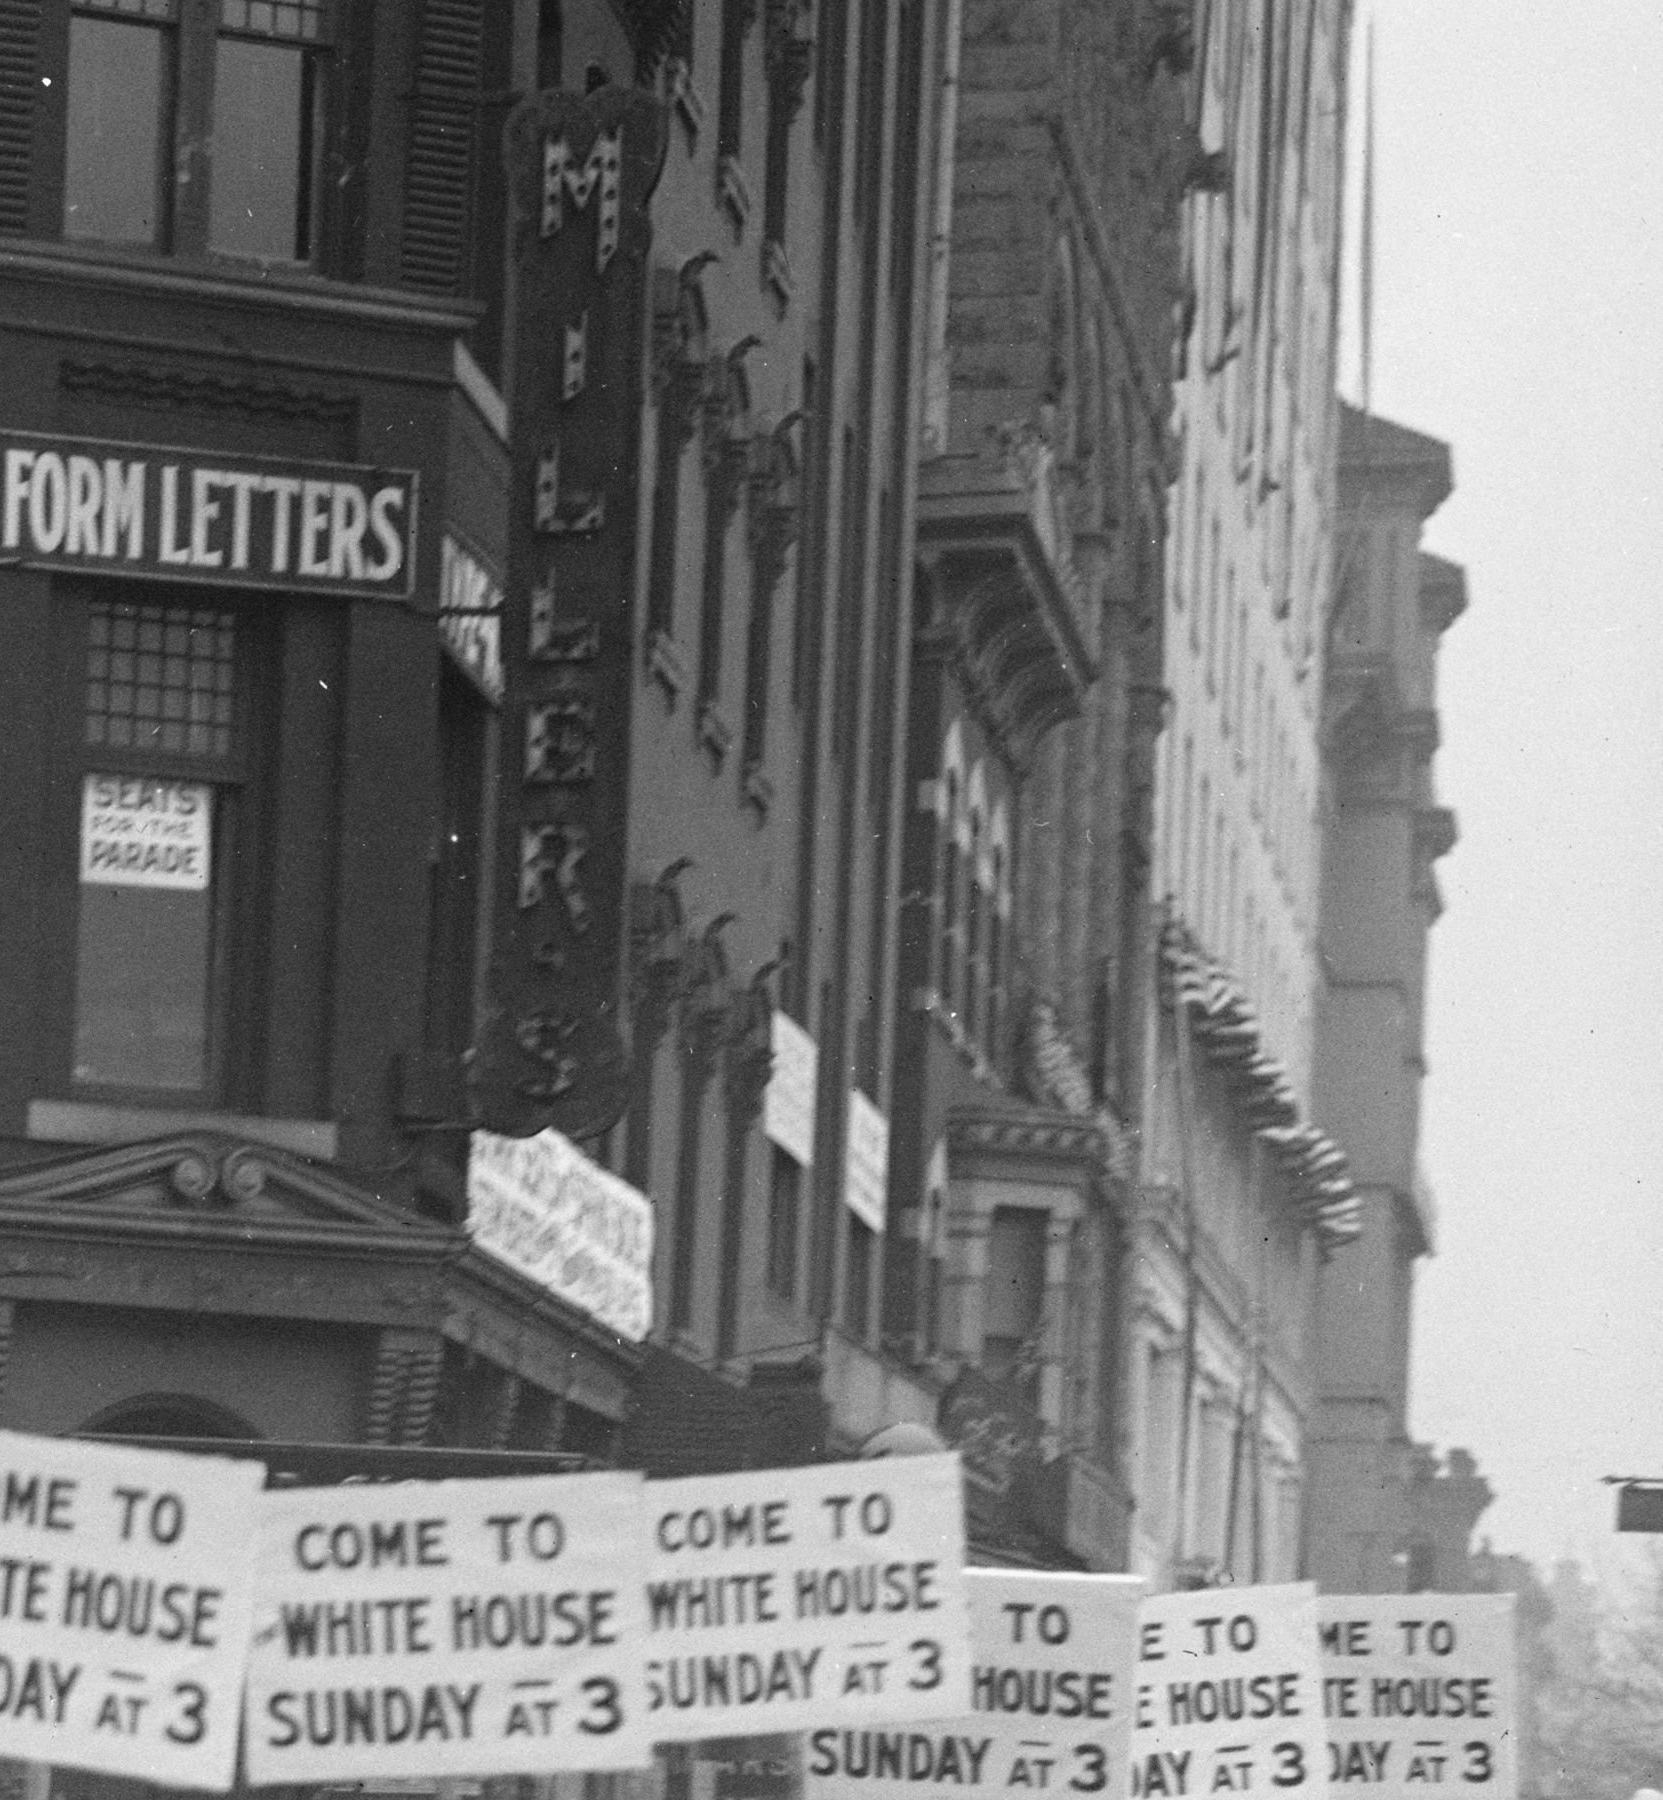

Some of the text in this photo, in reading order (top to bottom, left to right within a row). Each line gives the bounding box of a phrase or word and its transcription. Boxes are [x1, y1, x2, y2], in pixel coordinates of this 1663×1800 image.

[2, 448, 405, 582] FORM LETTERS
[90, 839, 198, 875] PARADE
[111, 1486, 187, 1546] TO
[294, 1511, 566, 1572] COME TO
[656, 1492, 894, 1553] COME TO
[62, 1567, 225, 1649] HOUSE
[280, 1590, 617, 1659] WHITE HOUSE
[645, 1560, 940, 1631] WHITE HOUSE
[1001, 1602, 1071, 1646] TO
[1192, 1613, 1258, 1656] TO
[1396, 1619, 1456, 1656] TO
[645, 1638, 943, 1712] SUNDAY AT 3
[971, 1665, 1113, 1719] HOUSE
[1168, 1673, 1302, 1726] HOUSE
[1371, 1676, 1494, 1719] HOUSE
[95, 1694, 149, 1735] AT
[164, 1680, 208, 1745] 3
[268, 1676, 624, 1748] SUNDAY AT 3
[809, 1728, 1107, 1793] SUNDAY AT 3
[1210, 1761, 1254, 1793] AT
[1271, 1741, 1307, 1787] 3
[1405, 1756, 1449, 1783] AT
[1462, 1741, 1494, 1784] 3
